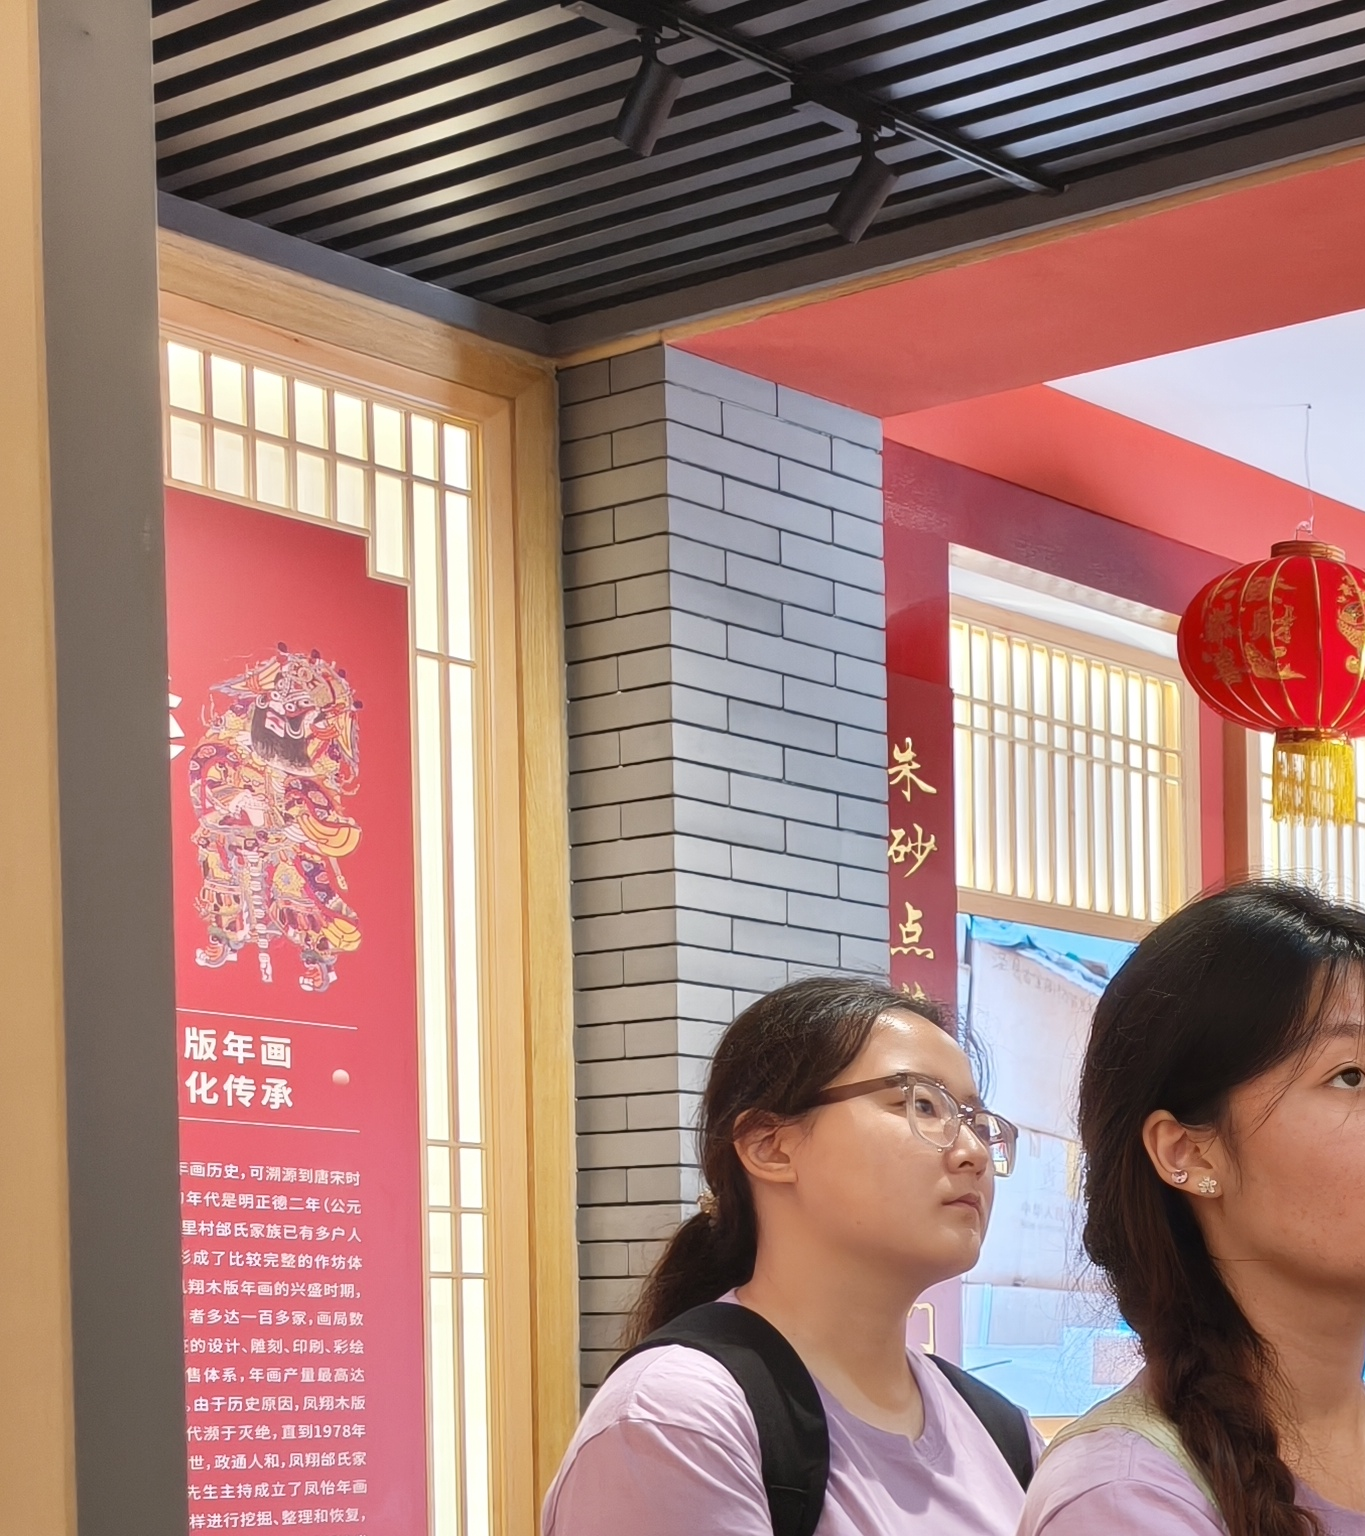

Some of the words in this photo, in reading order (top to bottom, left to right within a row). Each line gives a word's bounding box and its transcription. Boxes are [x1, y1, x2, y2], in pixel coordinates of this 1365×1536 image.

[184, 1026, 293, 1069] 版年画
[184, 1071, 293, 1110] 化传承
[181, 1190, 362, 1214] 年代是明正德二年（公元
[182, 1278, 361, 1299] 翔木版年画的兴盛时期，
